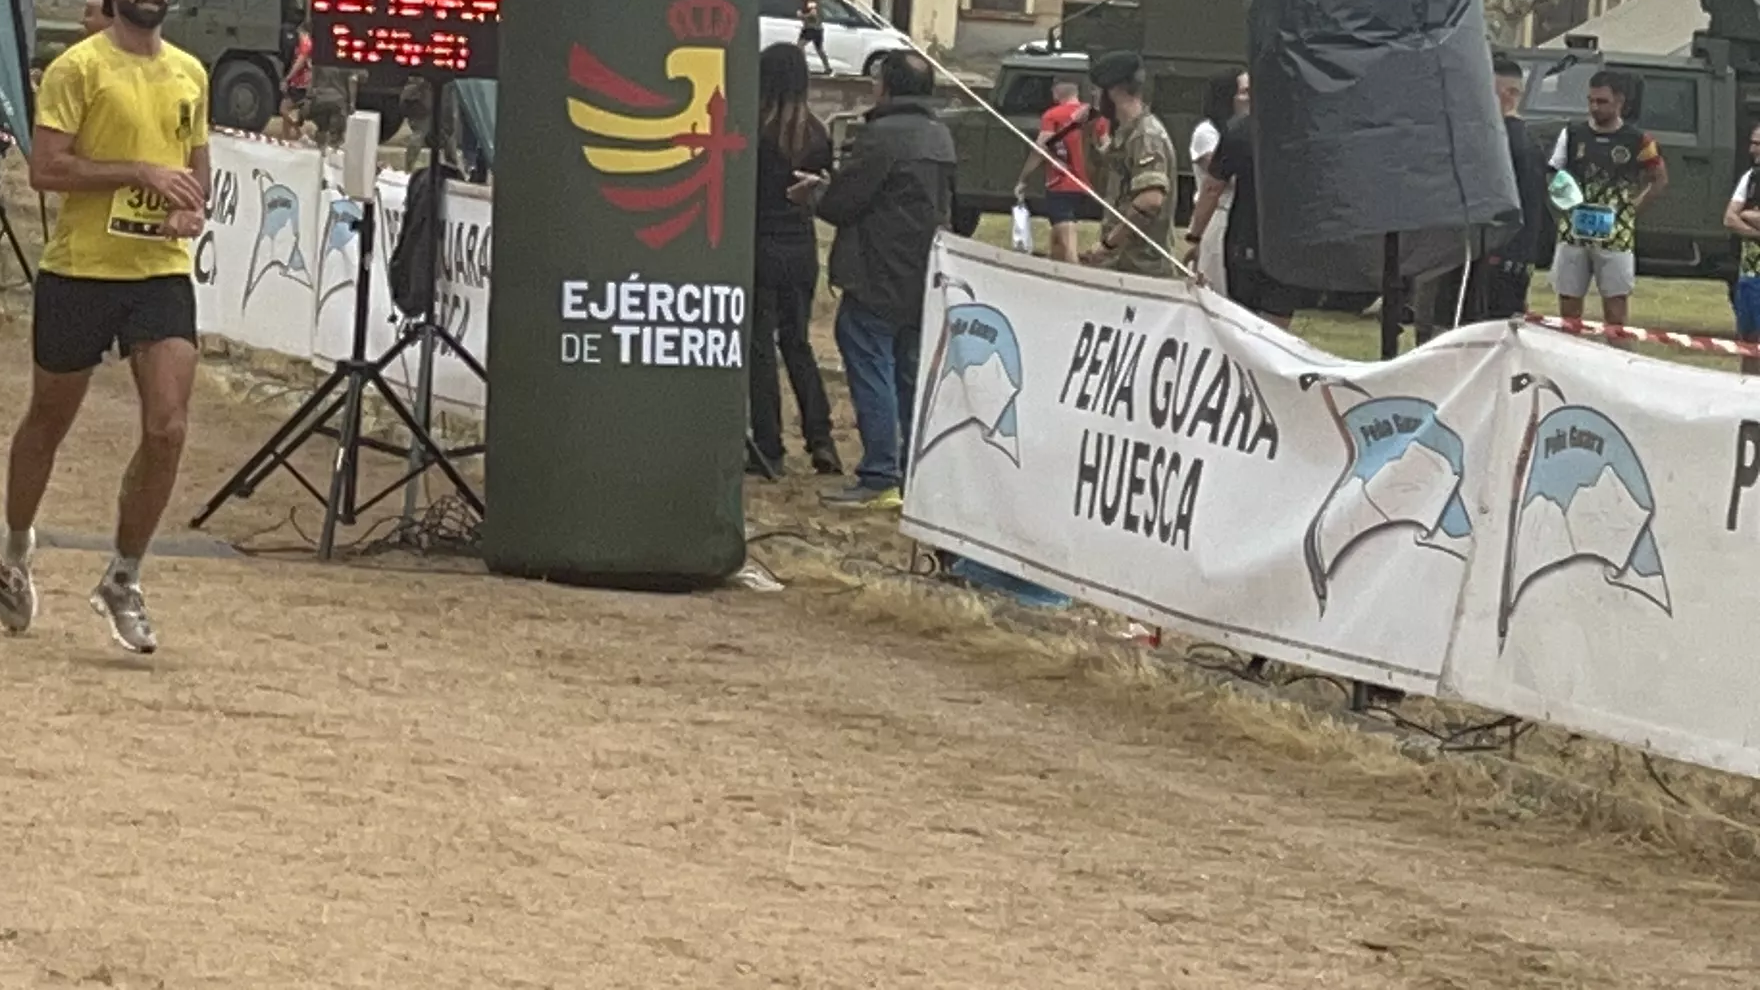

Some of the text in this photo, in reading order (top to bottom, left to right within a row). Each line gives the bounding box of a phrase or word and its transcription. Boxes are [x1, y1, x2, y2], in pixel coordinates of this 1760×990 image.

[562, 272, 745, 325] EJÉRCITO
[561, 325, 743, 368] DE TIERRA
[1059, 305, 1147, 422] PEÑA
[1074, 428, 1204, 551] HUESCA
